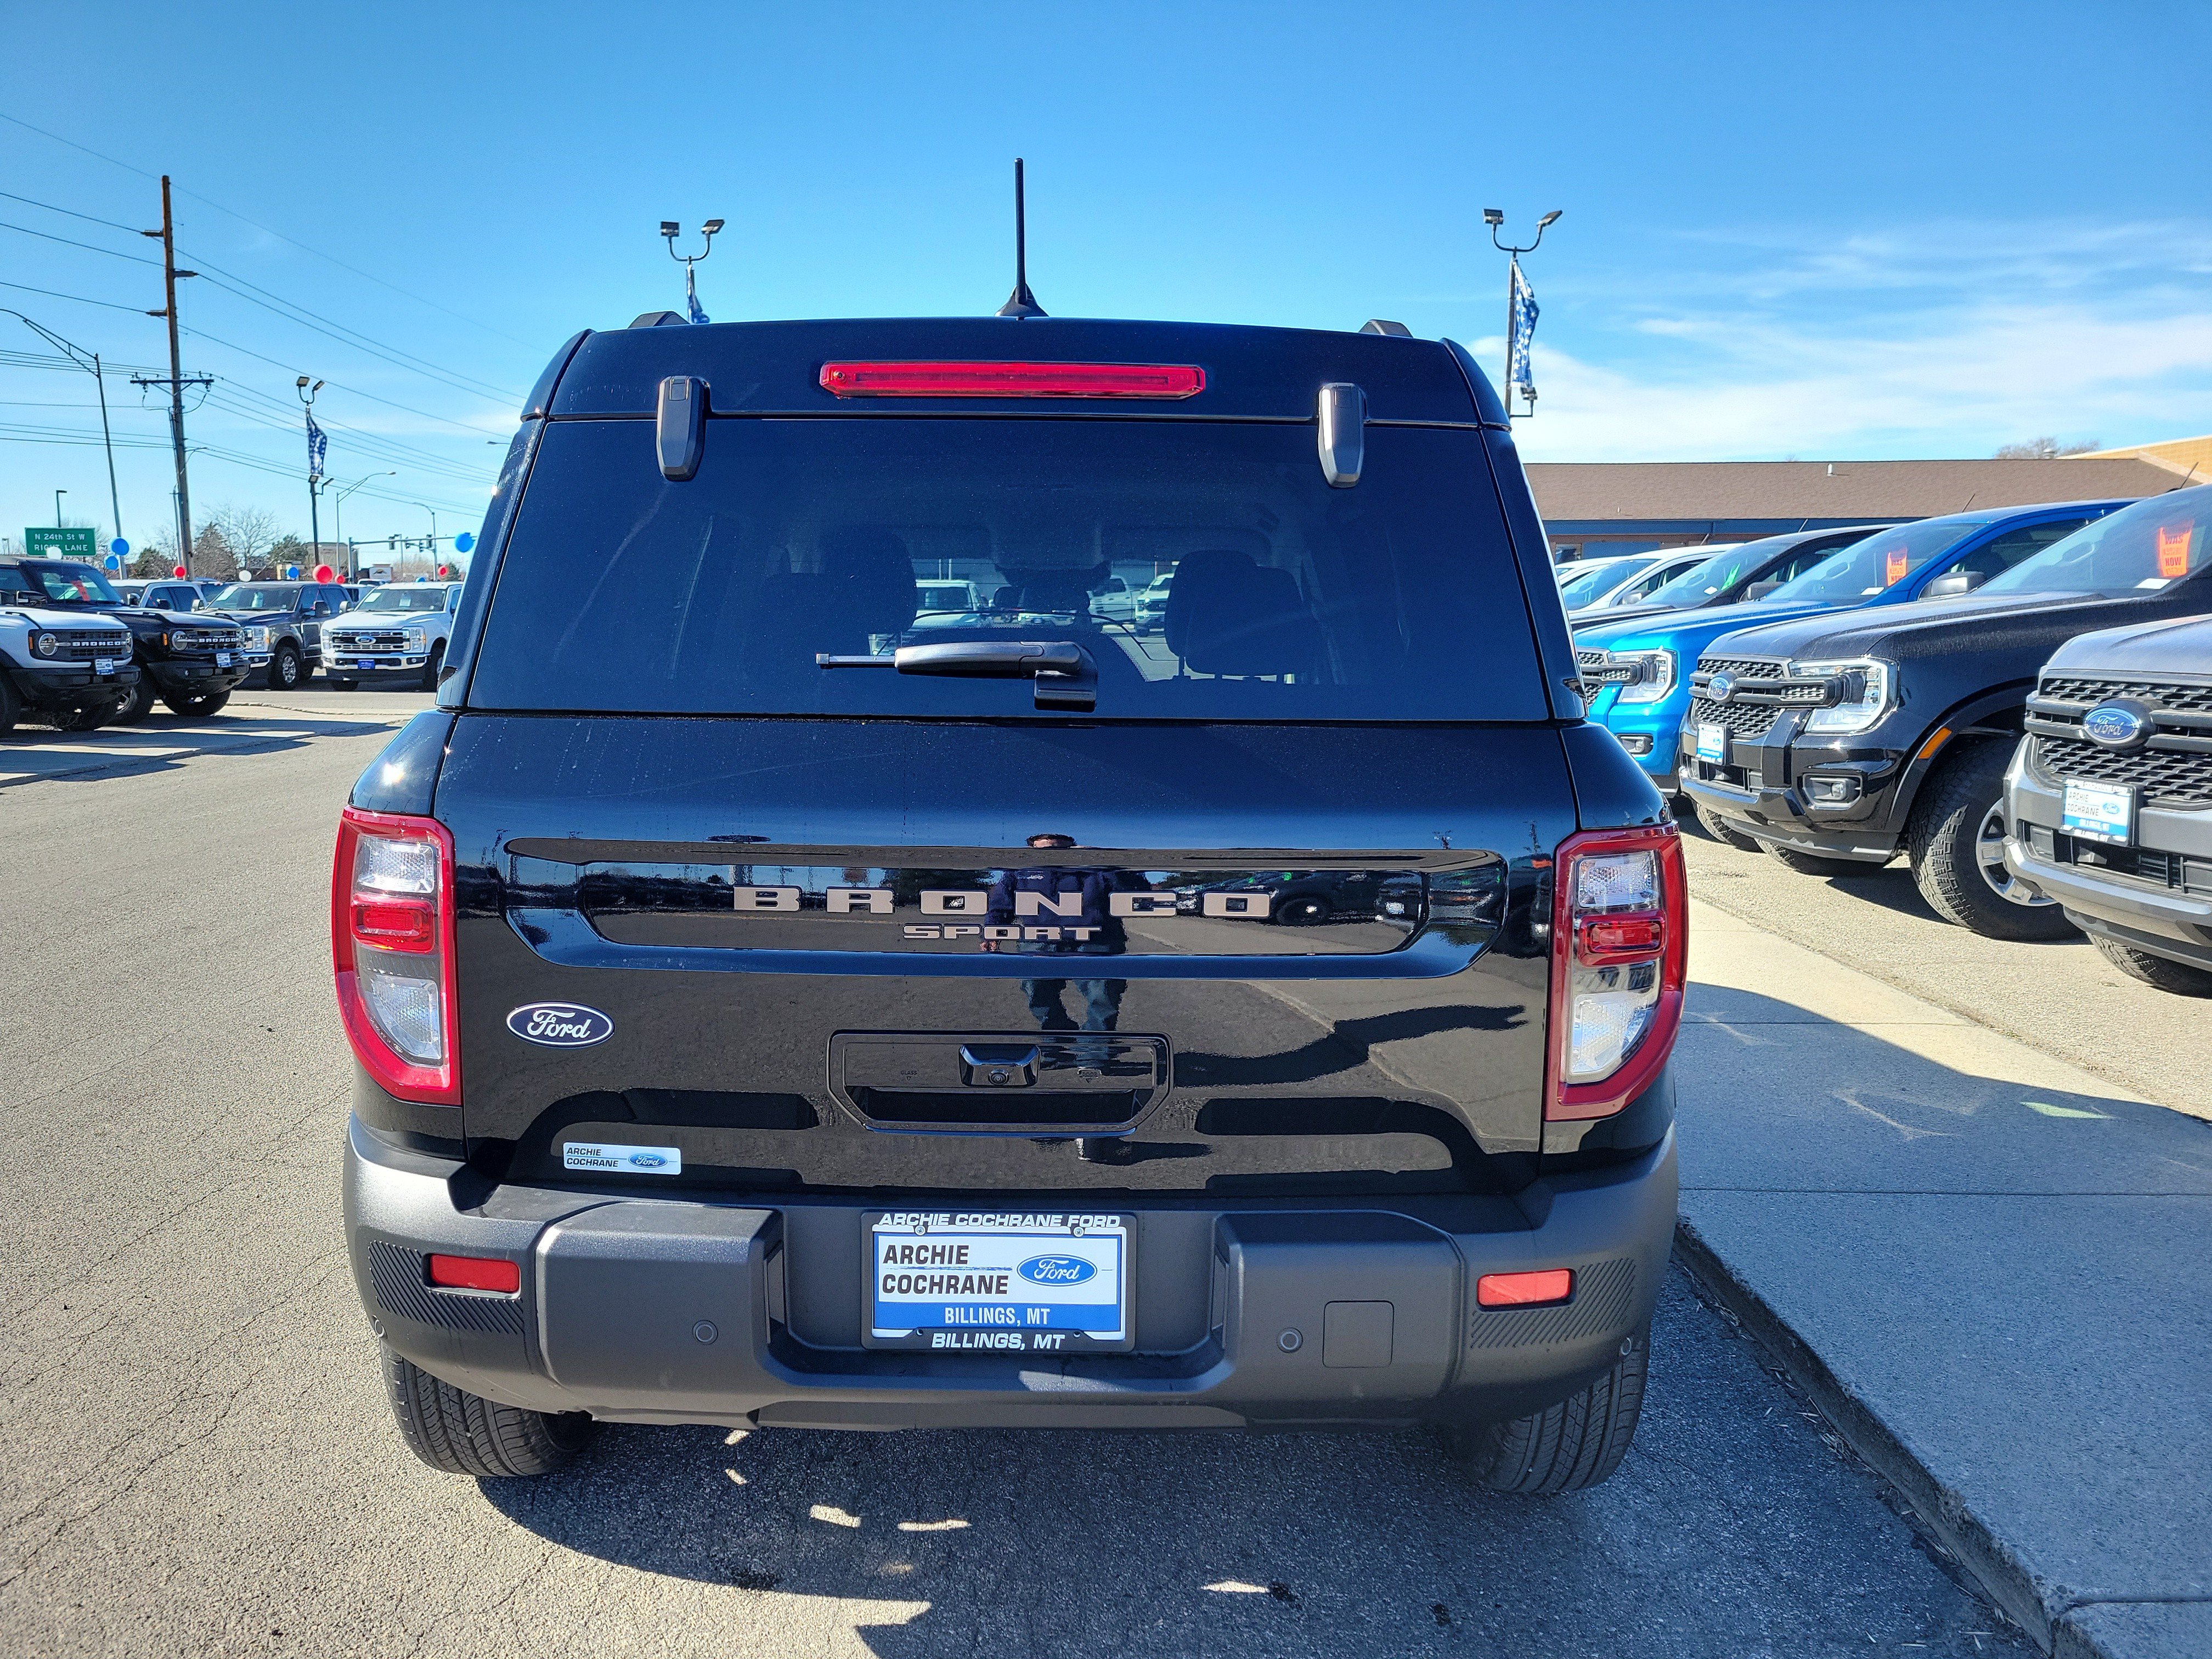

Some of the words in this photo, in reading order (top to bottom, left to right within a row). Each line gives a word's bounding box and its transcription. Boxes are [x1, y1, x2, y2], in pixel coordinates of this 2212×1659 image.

[2165, 556, 2182, 566] NOW
[2094, 715, 2124, 736] Ford
[2068, 792, 2089, 802] ARCHIE
[2067, 803, 2099, 816] COCHRANE
[733, 885, 1271, 918] BRONCO
[903, 923, 1101, 941] SPORT
[527, 1009, 592, 1038] Ford
[567, 1147, 602, 1156] ARCHIE
[635, 1155, 659, 1166] Ford
[567, 1158, 618, 1167] COCHRANE
[879, 1213, 950, 1226] ARCHIE
[955, 1214, 1063, 1227] COCHRANE
[1066, 1215, 1120, 1228] FORD
[882, 1244, 969, 1265] ARCHIE
[1034, 1259, 1080, 1280] Ford
[882, 1274, 1009, 1295] COCHRANE
[945, 1307, 1020, 1327] BILLINGS,
[1027, 1308, 1050, 1324] MT
[932, 1333, 1025, 1351] BILLINGS,
[1033, 1334, 1065, 1349] MT
